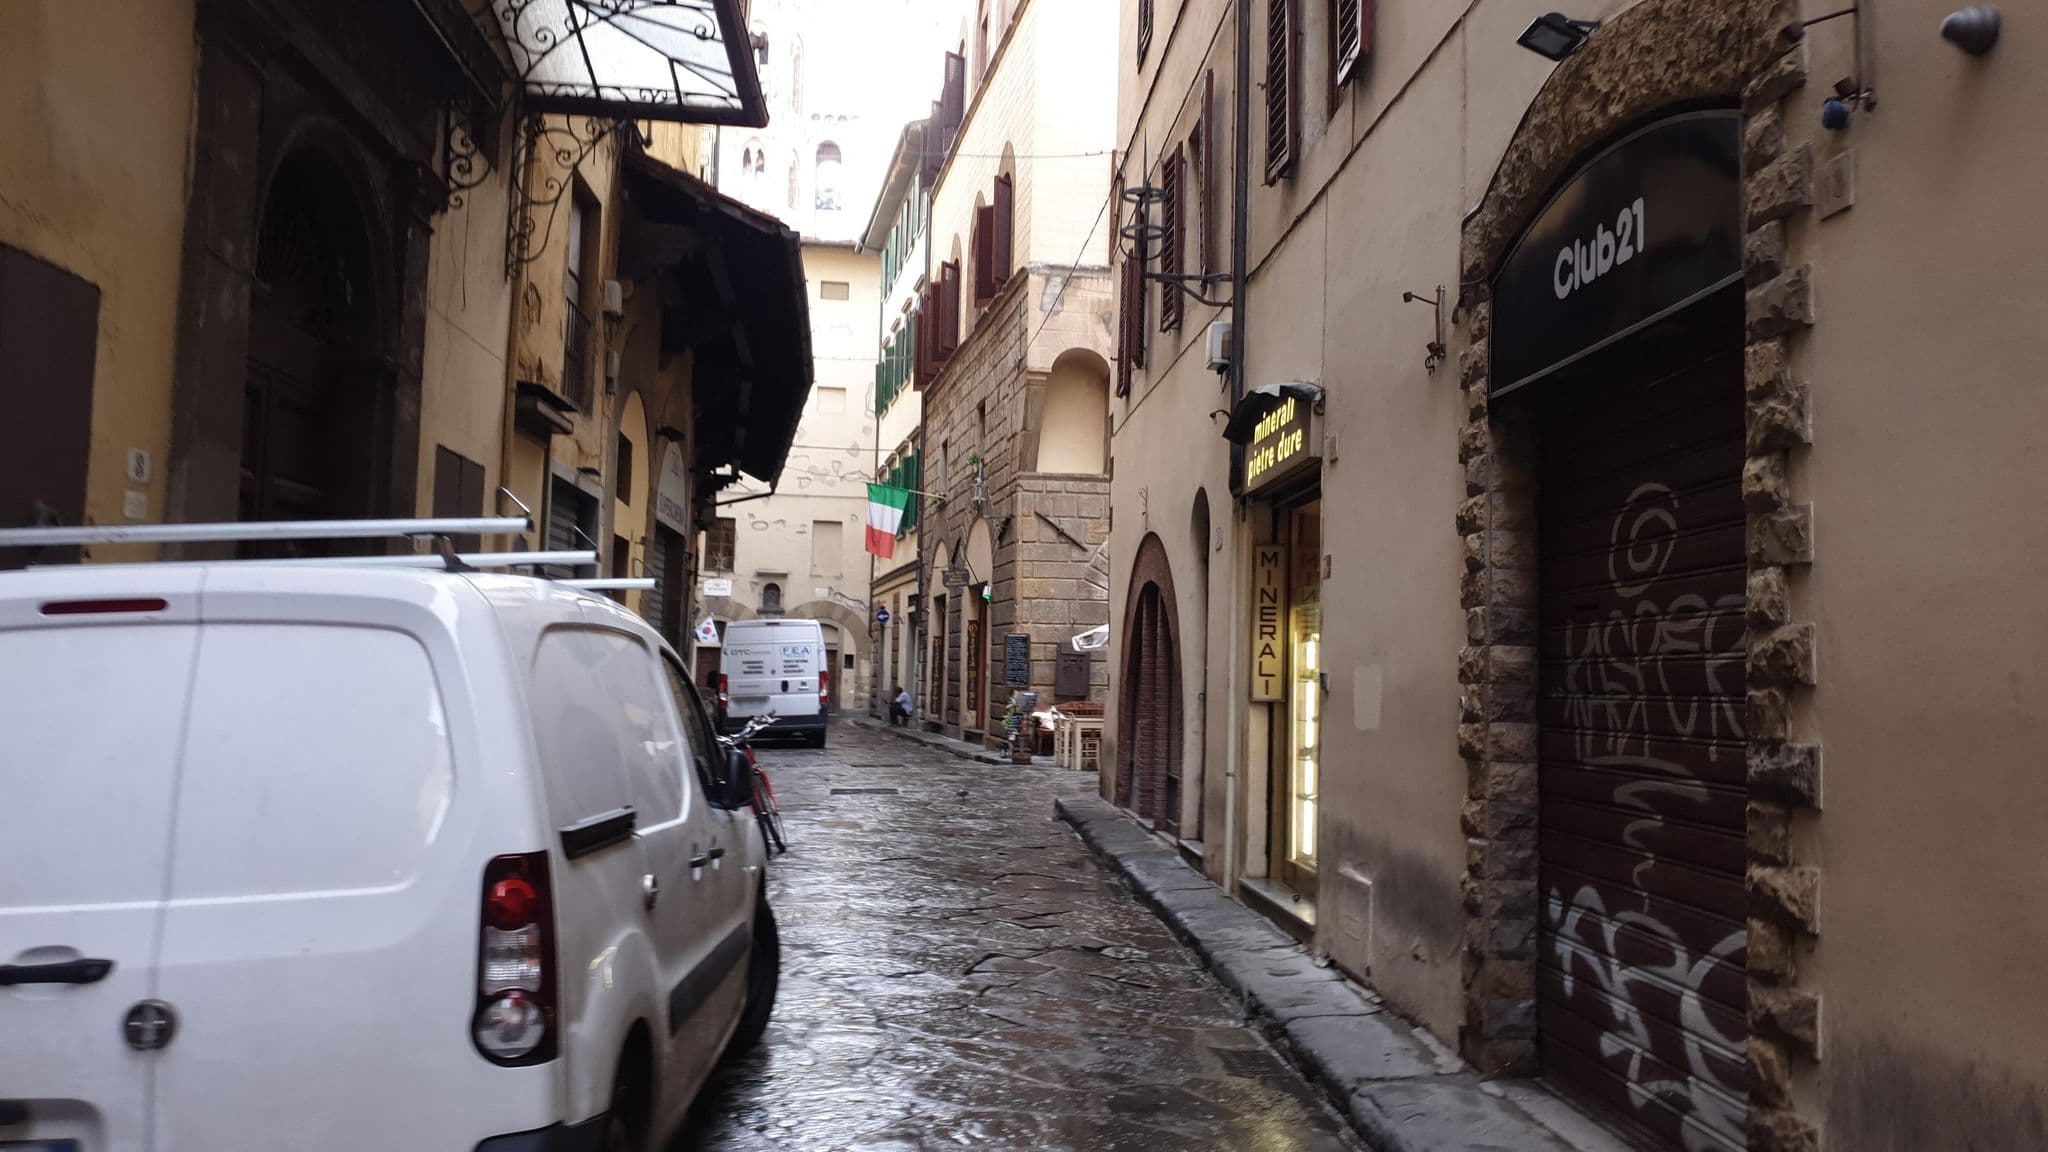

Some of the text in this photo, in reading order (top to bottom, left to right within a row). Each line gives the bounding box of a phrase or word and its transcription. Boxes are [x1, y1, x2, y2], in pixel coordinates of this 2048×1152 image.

[1553, 196, 1645, 300] Club21
[1247, 428, 1303, 487] pietre dure
[1253, 395, 1296, 446] minerali
[1258, 551, 1279, 696] MINERALI
